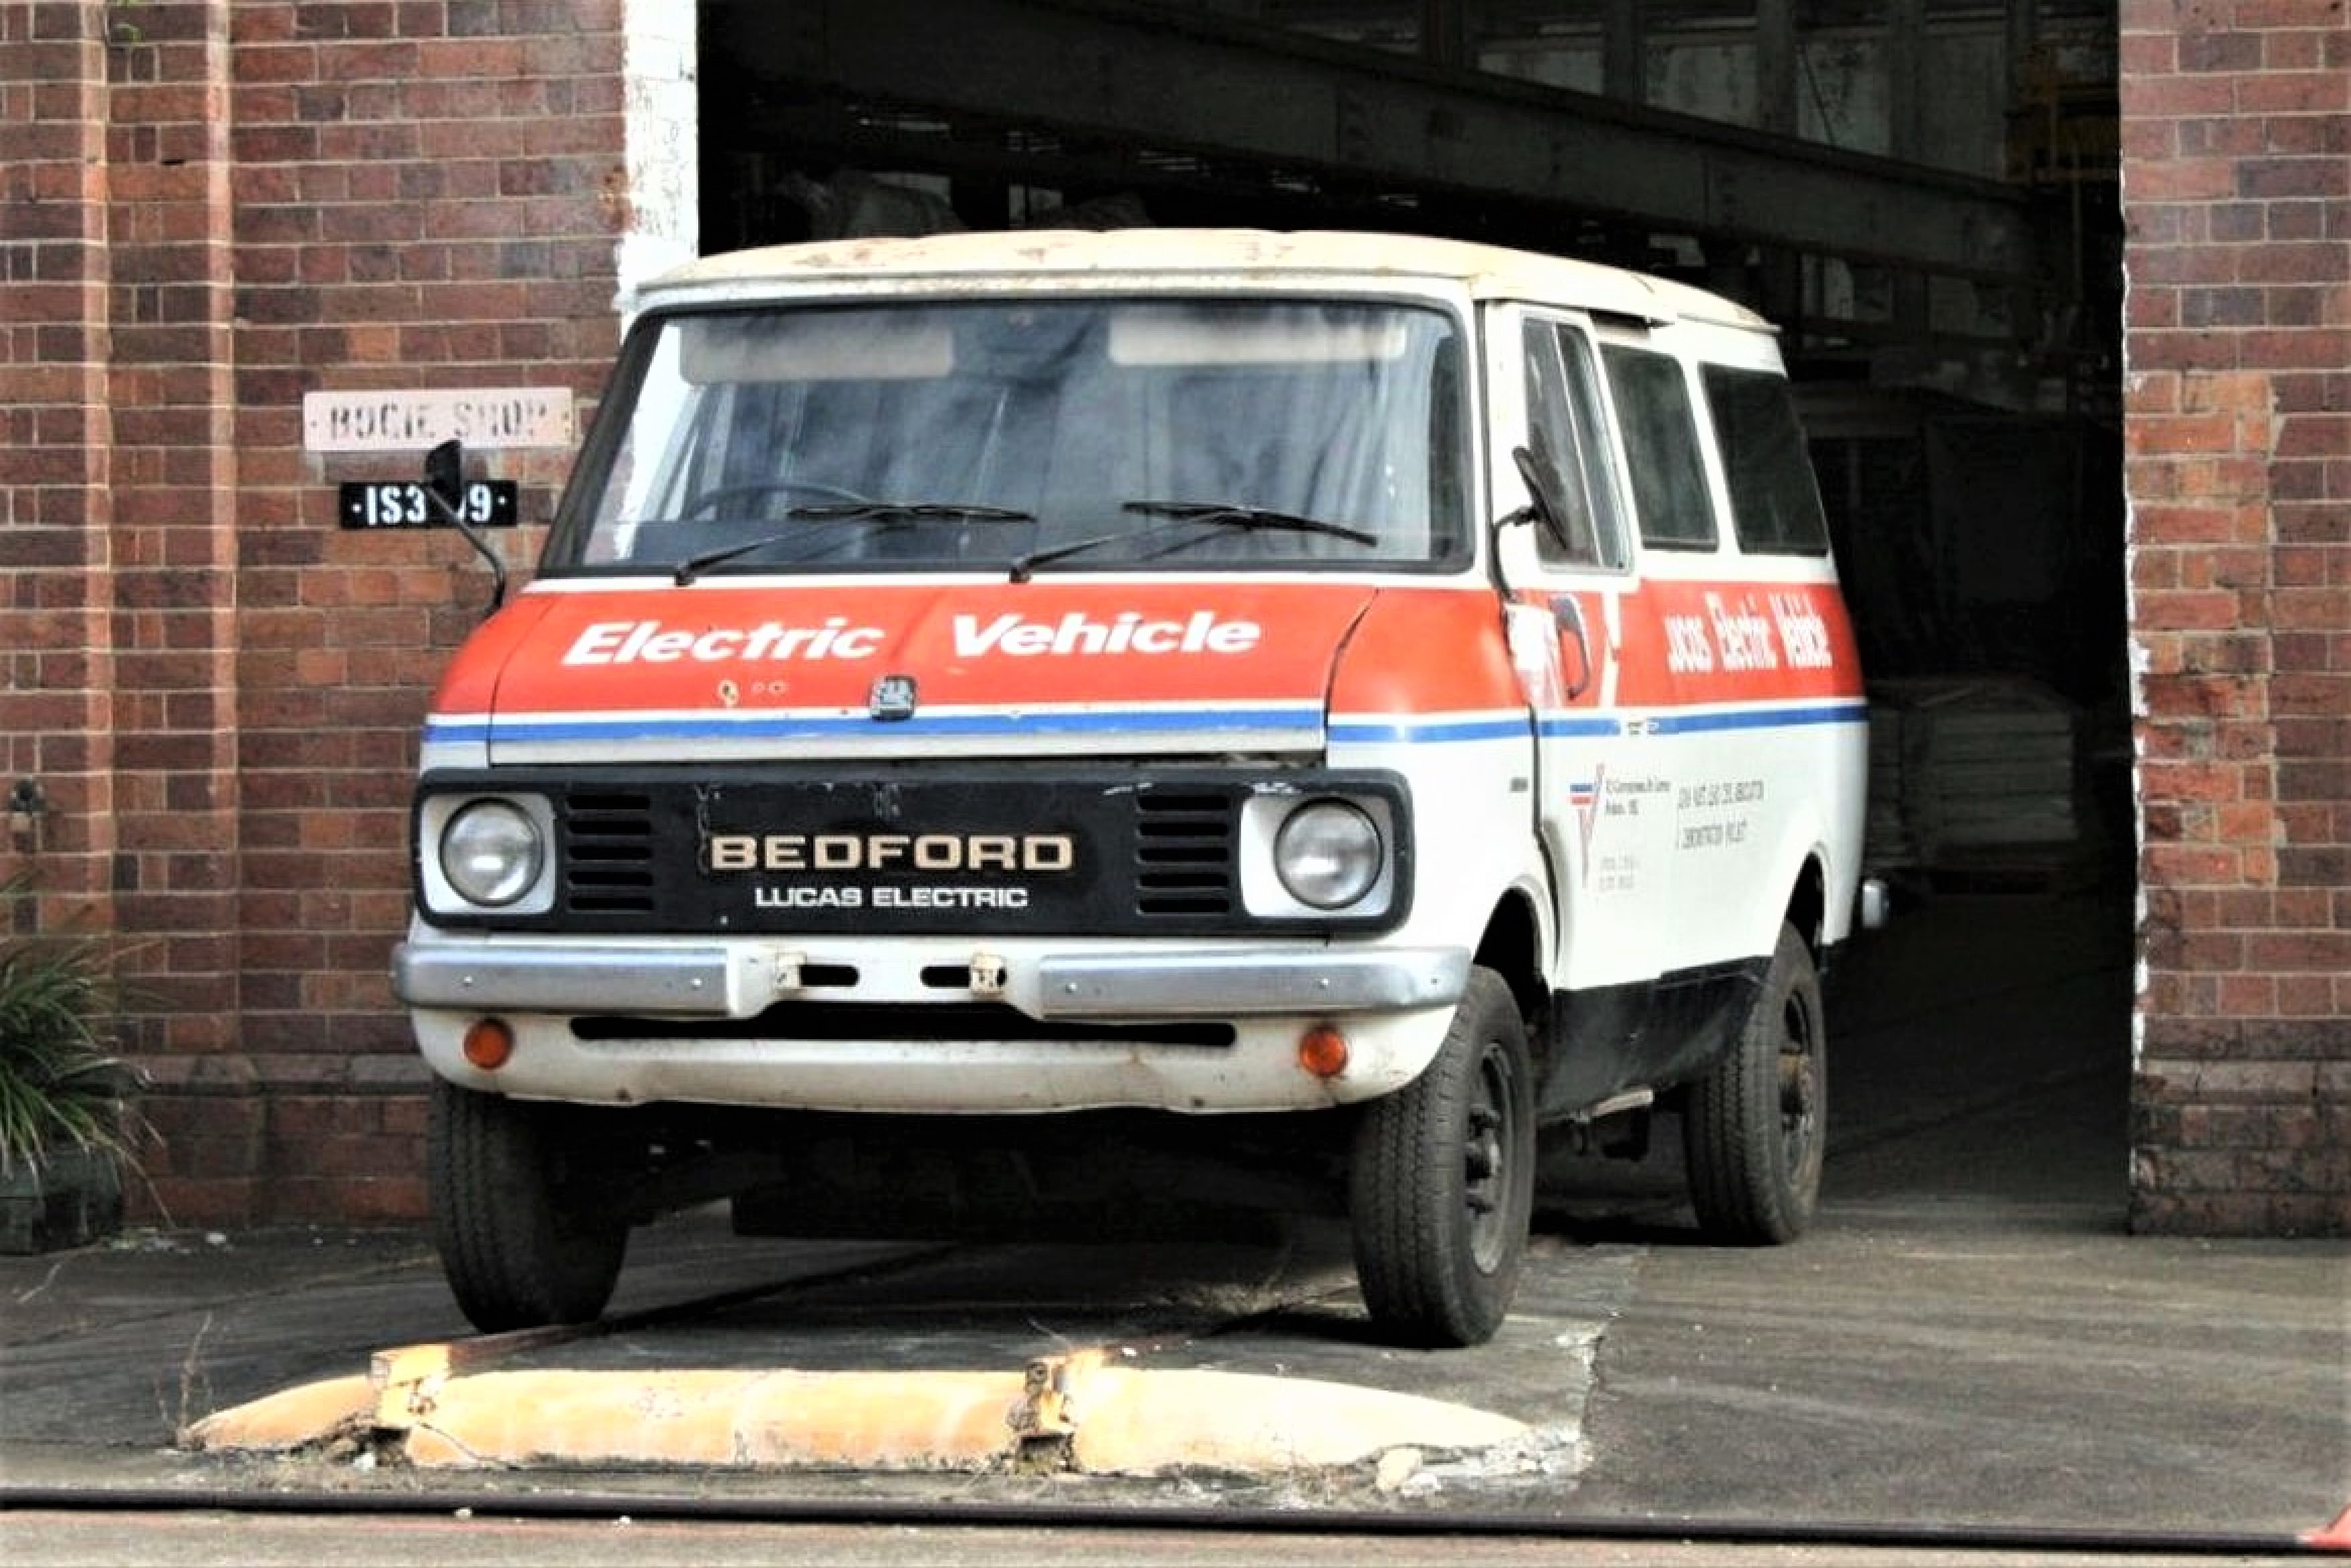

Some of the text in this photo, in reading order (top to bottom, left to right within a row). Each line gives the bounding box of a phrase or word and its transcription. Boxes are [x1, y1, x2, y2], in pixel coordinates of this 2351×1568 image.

[561, 610, 1262, 665] Electric Vehicle
[710, 834, 1075, 871] BEDFORD
[755, 887, 1029, 908] LUCAS ELECTRIC
